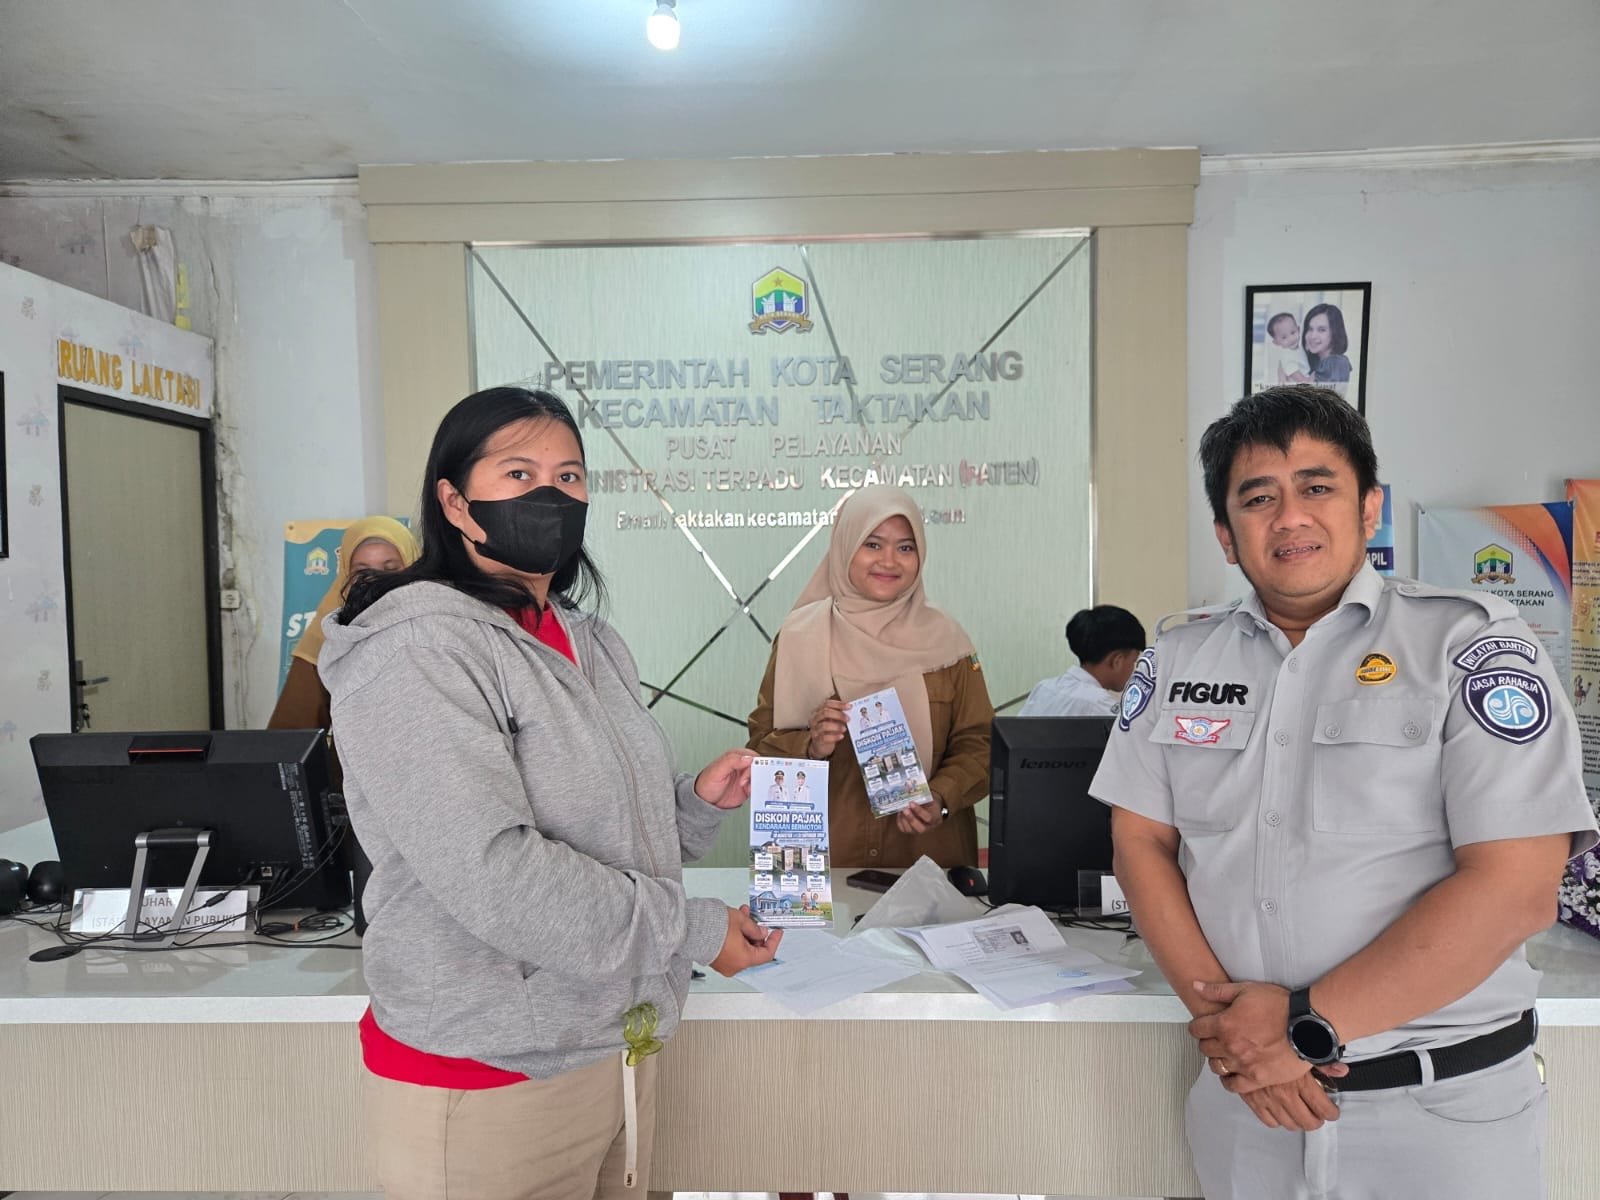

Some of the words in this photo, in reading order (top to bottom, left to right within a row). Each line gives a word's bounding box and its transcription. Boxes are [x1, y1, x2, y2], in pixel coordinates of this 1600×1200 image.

[58, 338, 123, 391] RUANG
[130, 359, 201, 410] LAKTASI
[543, 358, 750, 391] PEMERINTAH
[770, 354, 858, 388] KOTA
[879, 351, 1024, 385] SERANG
[578, 396, 779, 430] KECAMATAN
[812, 391, 991, 425] TAKTAKAN
[666, 435, 737, 461] PUSAT
[772, 432, 903, 459] PELAYANAN
[703, 466, 805, 493] TERPADU
[820, 463, 953, 489] KECAMATAN
[1516, 589, 1555, 599] SERANG
[1463, 642, 1498, 666] WILAYAH
[1498, 640, 1534, 660] BANTEN
[1168, 681, 1249, 706] FIGUR
[1471, 677, 1497, 691] JASA
[1498, 675, 1540, 694] RAHARJA
[1019, 758, 1087, 769] lenovo
[755, 812, 790, 824] DISKON
[791, 813, 822, 824] PAJAK
